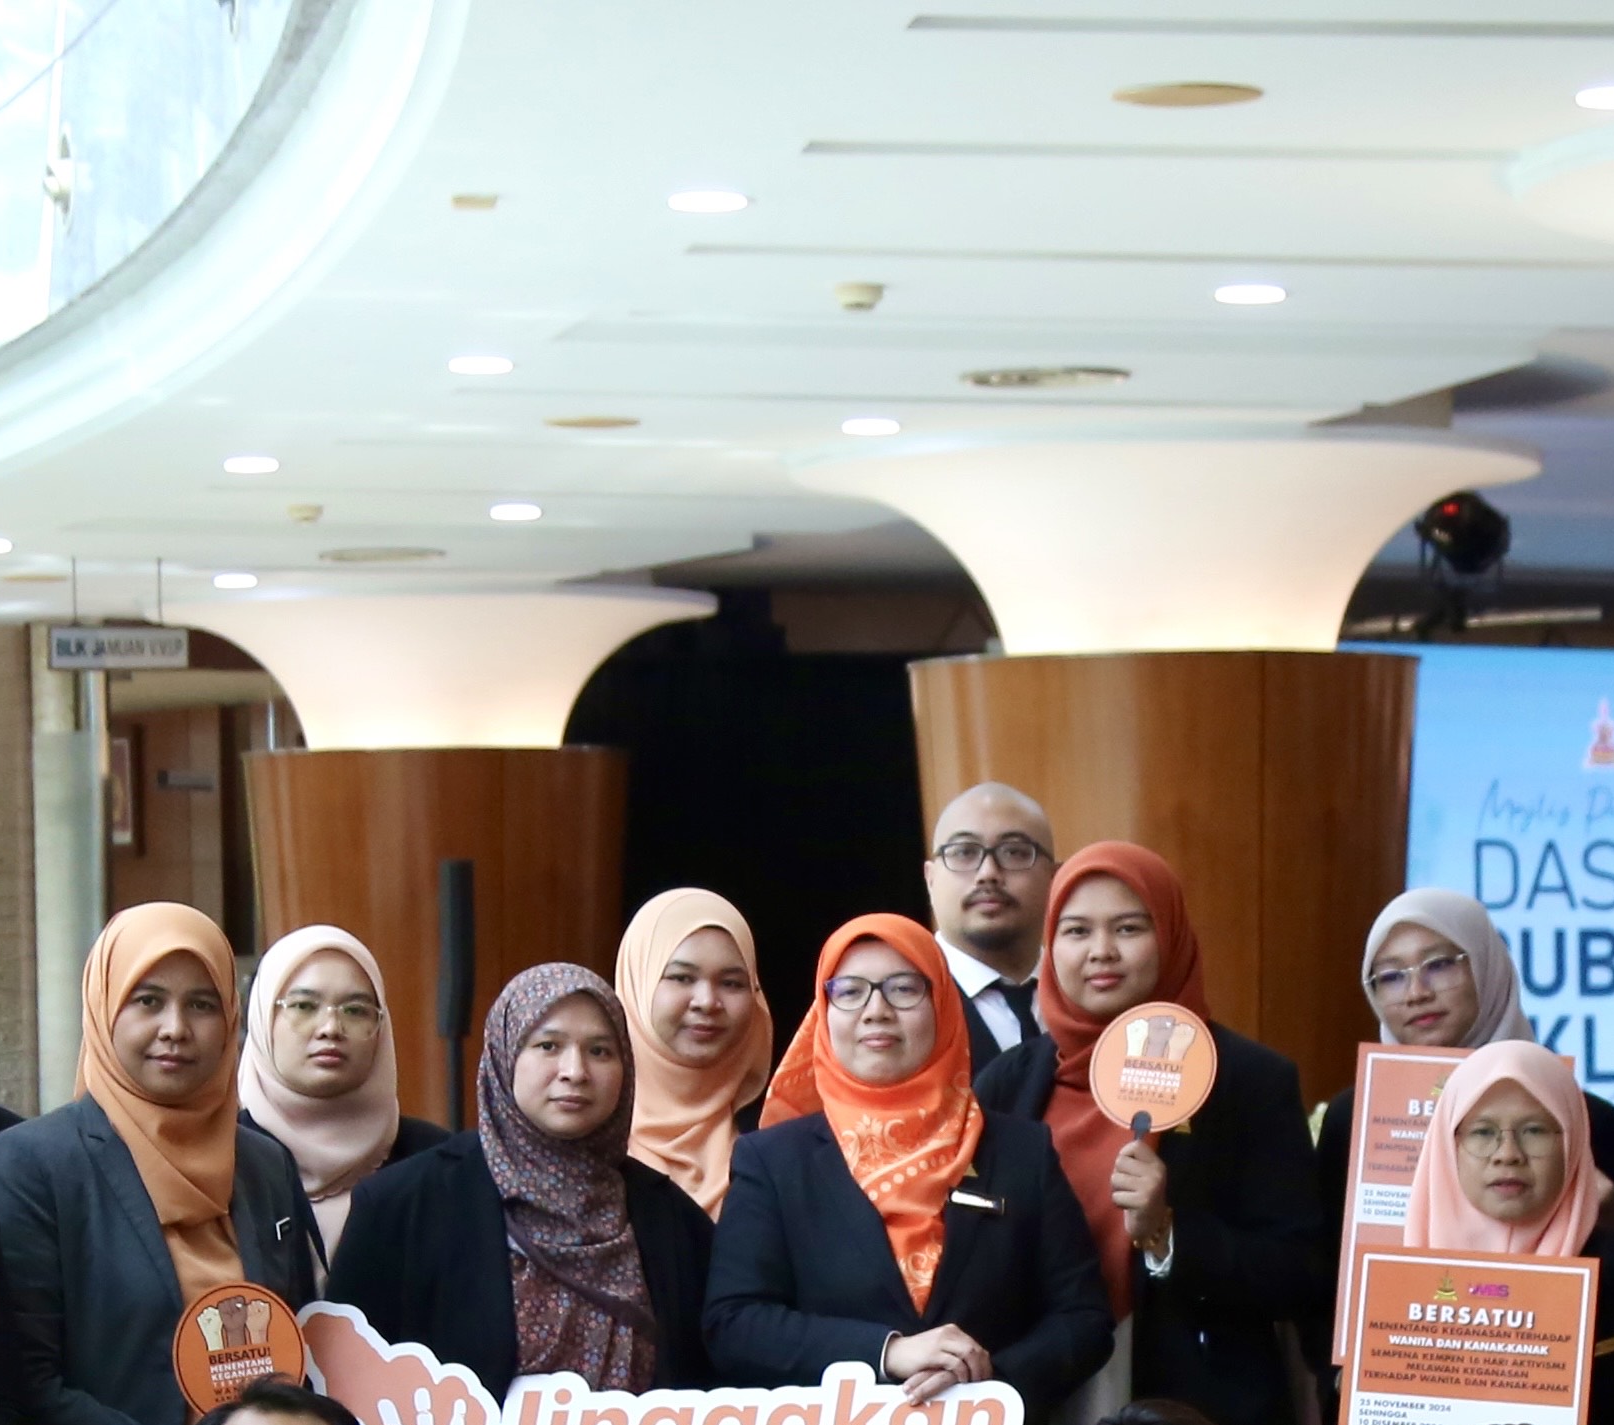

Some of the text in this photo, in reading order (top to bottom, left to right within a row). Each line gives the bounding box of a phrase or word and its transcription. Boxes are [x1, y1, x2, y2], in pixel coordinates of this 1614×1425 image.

[1409, 1303, 1535, 1329] BERSATU!
[1369, 1321, 1571, 1343] MENENTANG KEGANASAN TERHADAP
[1389, 1335, 1549, 1355] WANITA DAN KANAK-KANAK
[209, 1347, 270, 1365] BERSATU!
[210, 1357, 271, 1373] MENENTANG
[1371, 1349, 1566, 1370] SEMPENA KEMPEN 16 HARI AKTIVISME
[211, 1366, 273, 1381] KEGANASAN
[1406, 1363, 1529, 1379] MELAWAN KEGANASAN
[1364, 1370, 1569, 1393] TERHADAP WANITA DAN KANAK-KANAK
[1359, 1409, 1407, 1418] SEHINGGA
[1360, 1398, 1451, 1412] 25 NOVEMBER 2024
